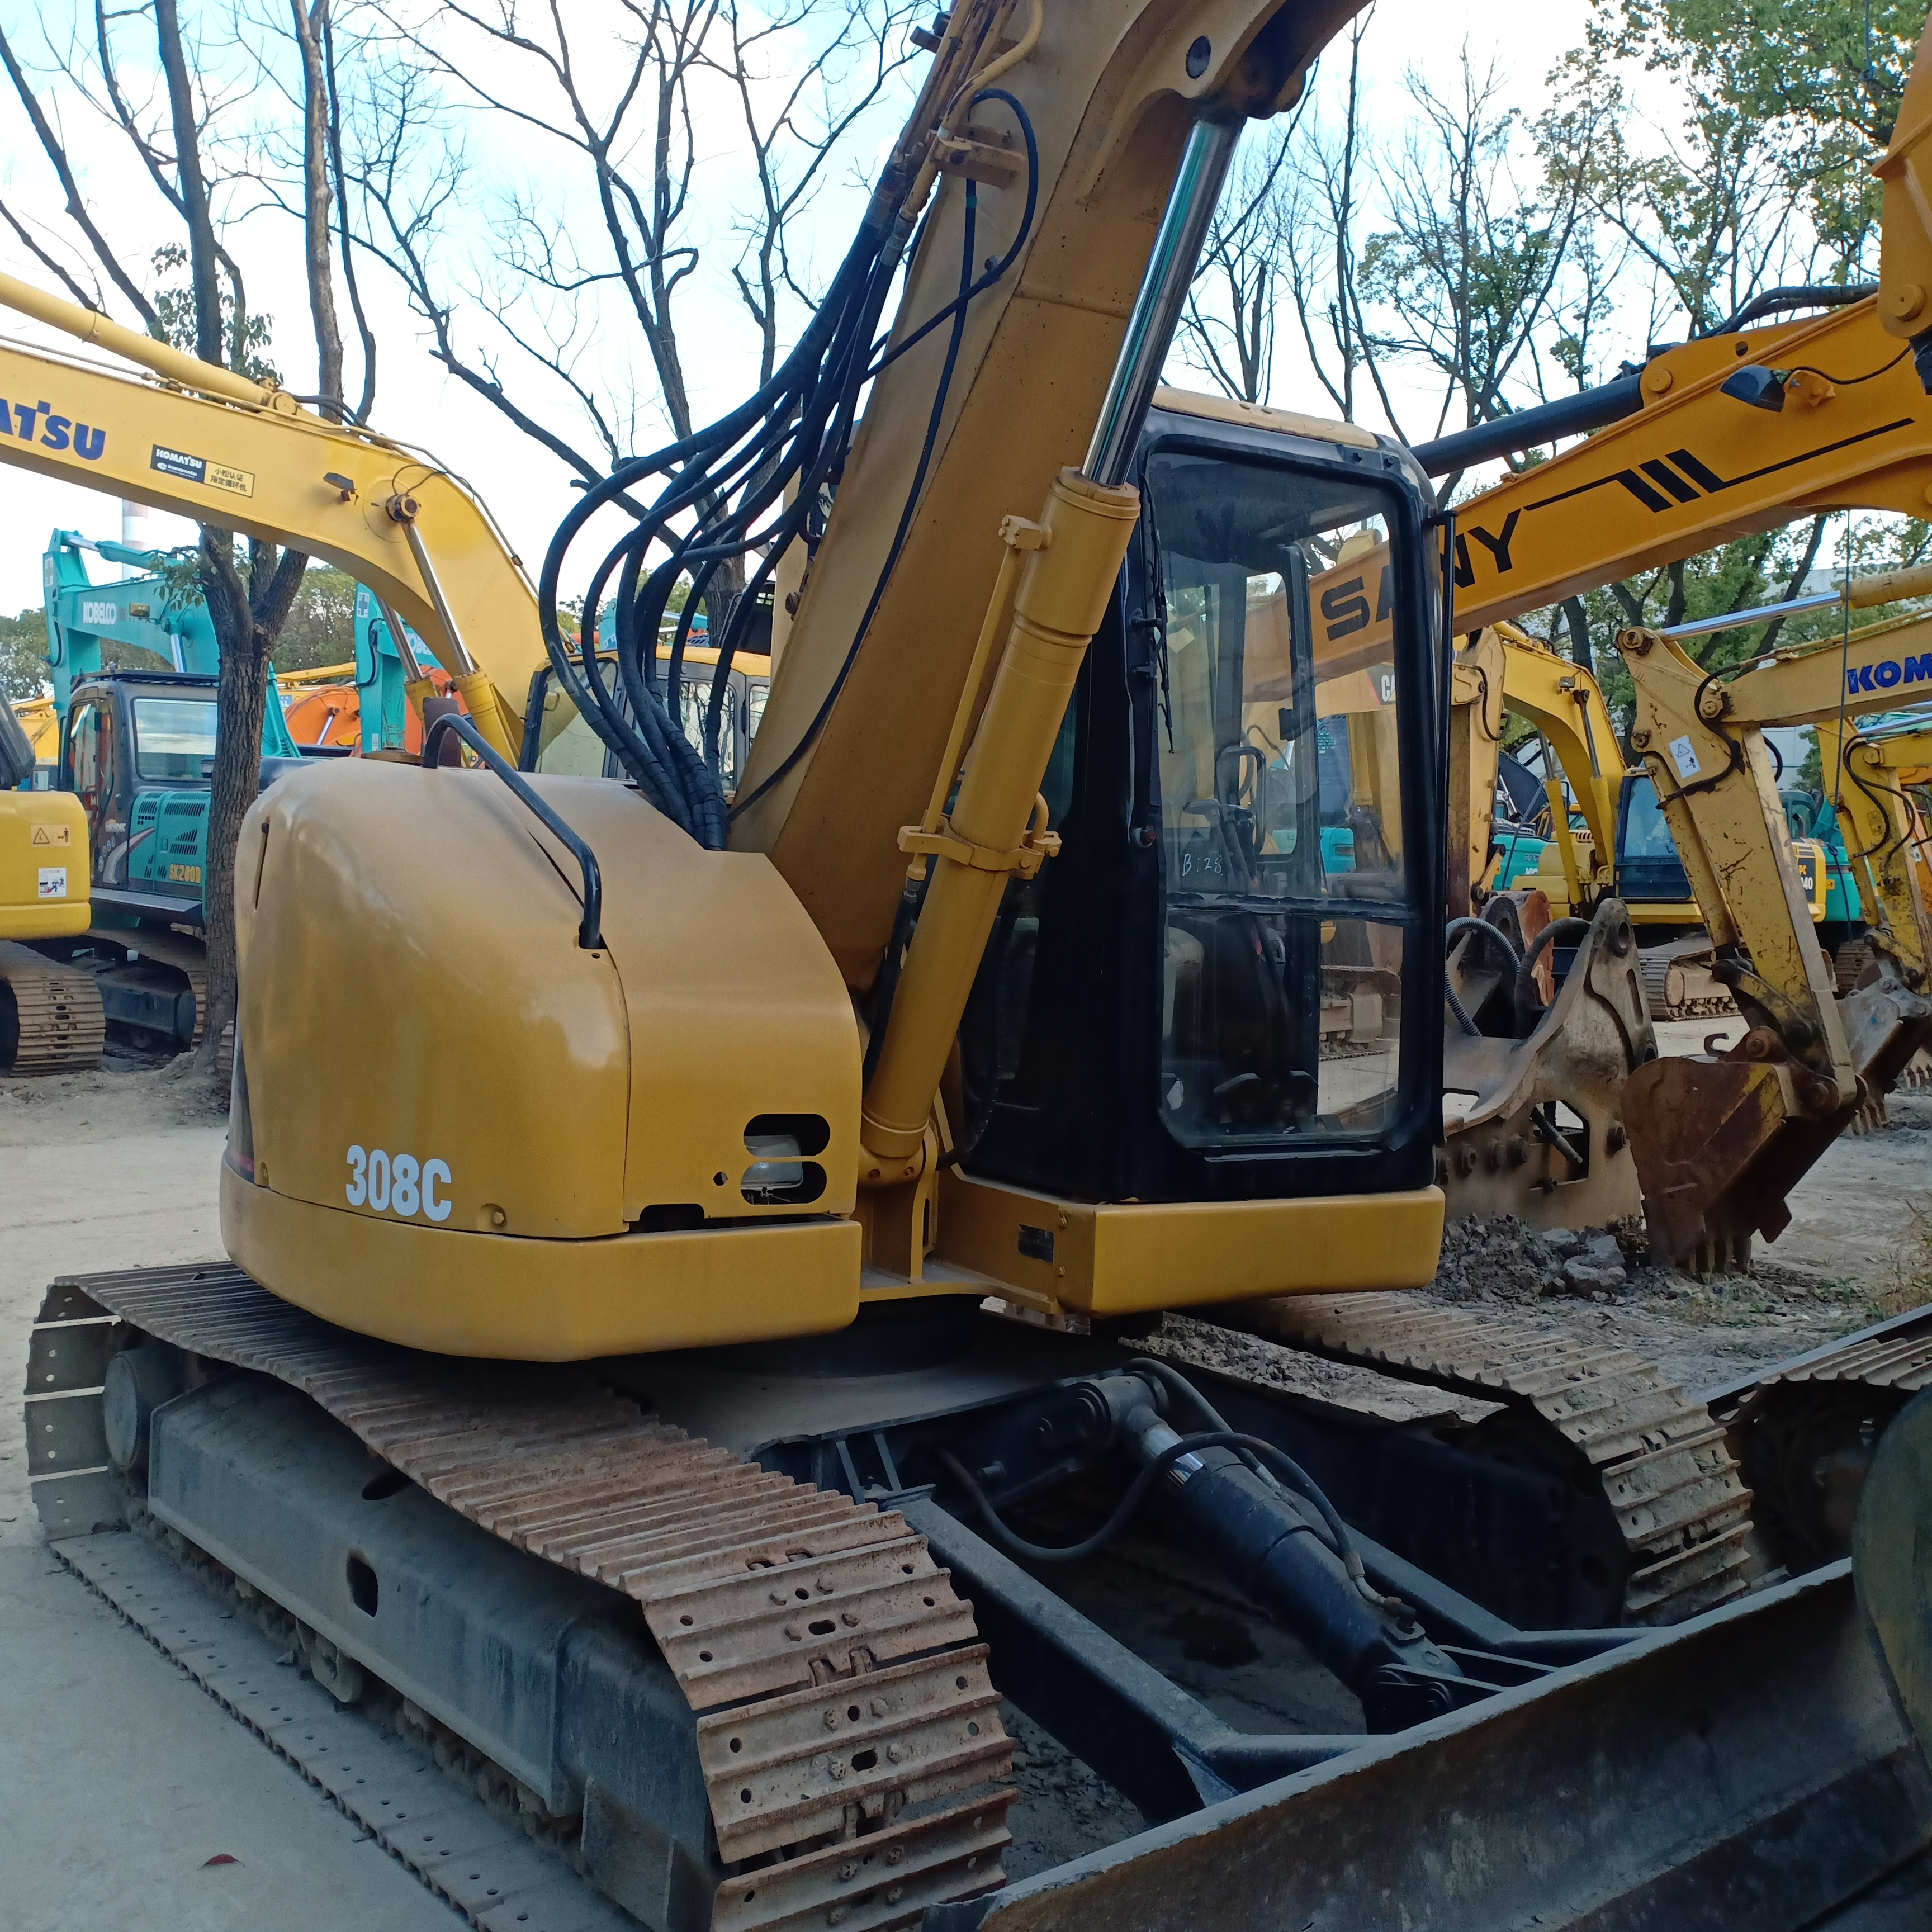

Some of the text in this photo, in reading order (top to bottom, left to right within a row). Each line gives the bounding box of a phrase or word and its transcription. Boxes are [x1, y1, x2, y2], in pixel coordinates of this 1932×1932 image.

[156, 448, 202, 469] KOMATSU
[210, 475, 247, 492] 指定循环机
[215, 467, 244, 482] 小松认证
[83, 601, 117, 625] KOBELCO
[345, 1144, 452, 1222] 308C
